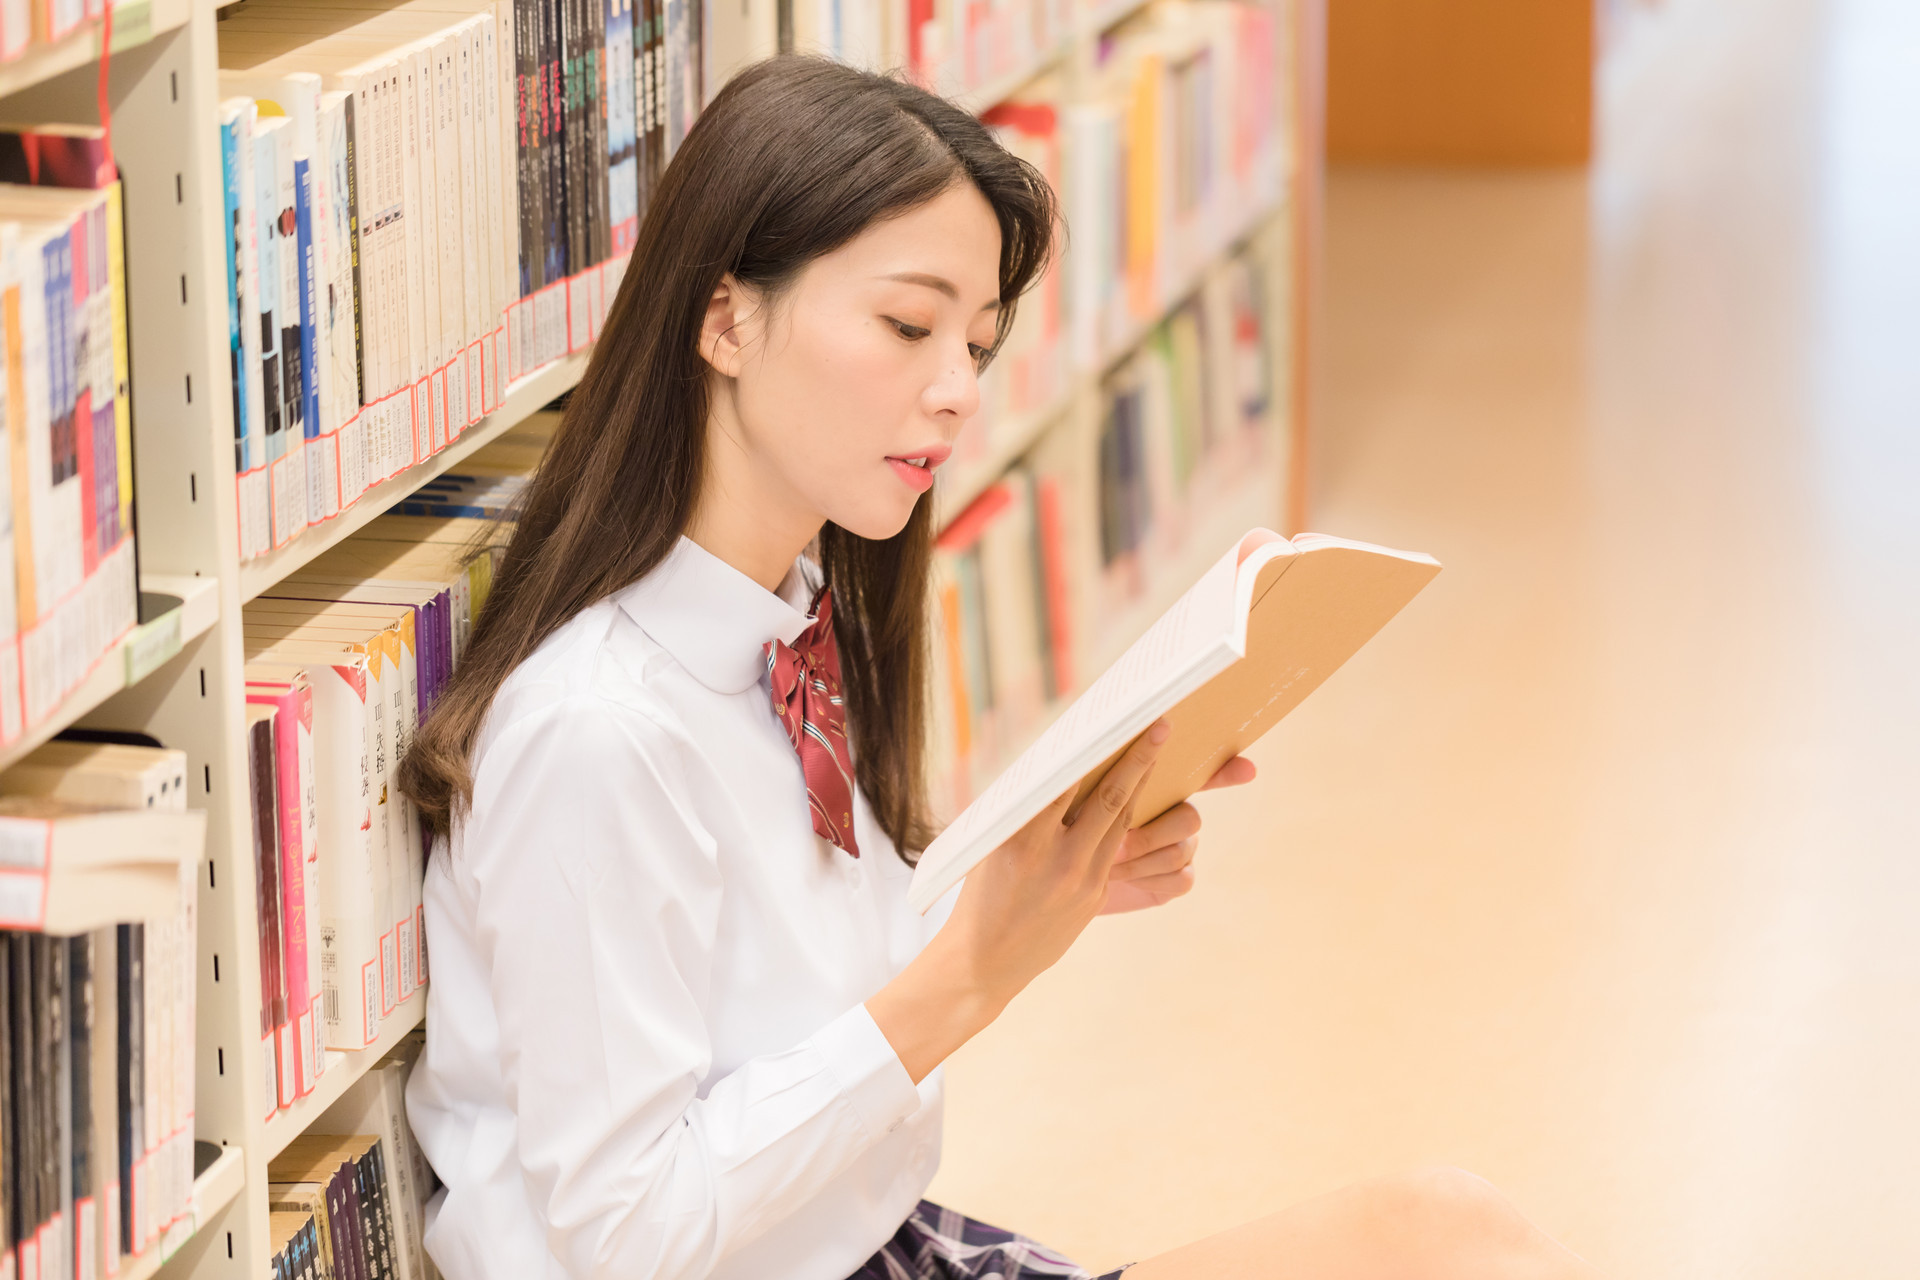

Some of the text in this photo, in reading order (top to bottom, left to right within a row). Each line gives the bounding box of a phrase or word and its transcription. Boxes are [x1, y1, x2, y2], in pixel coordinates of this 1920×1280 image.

[288, 802, 305, 953] The Subtle Knife
